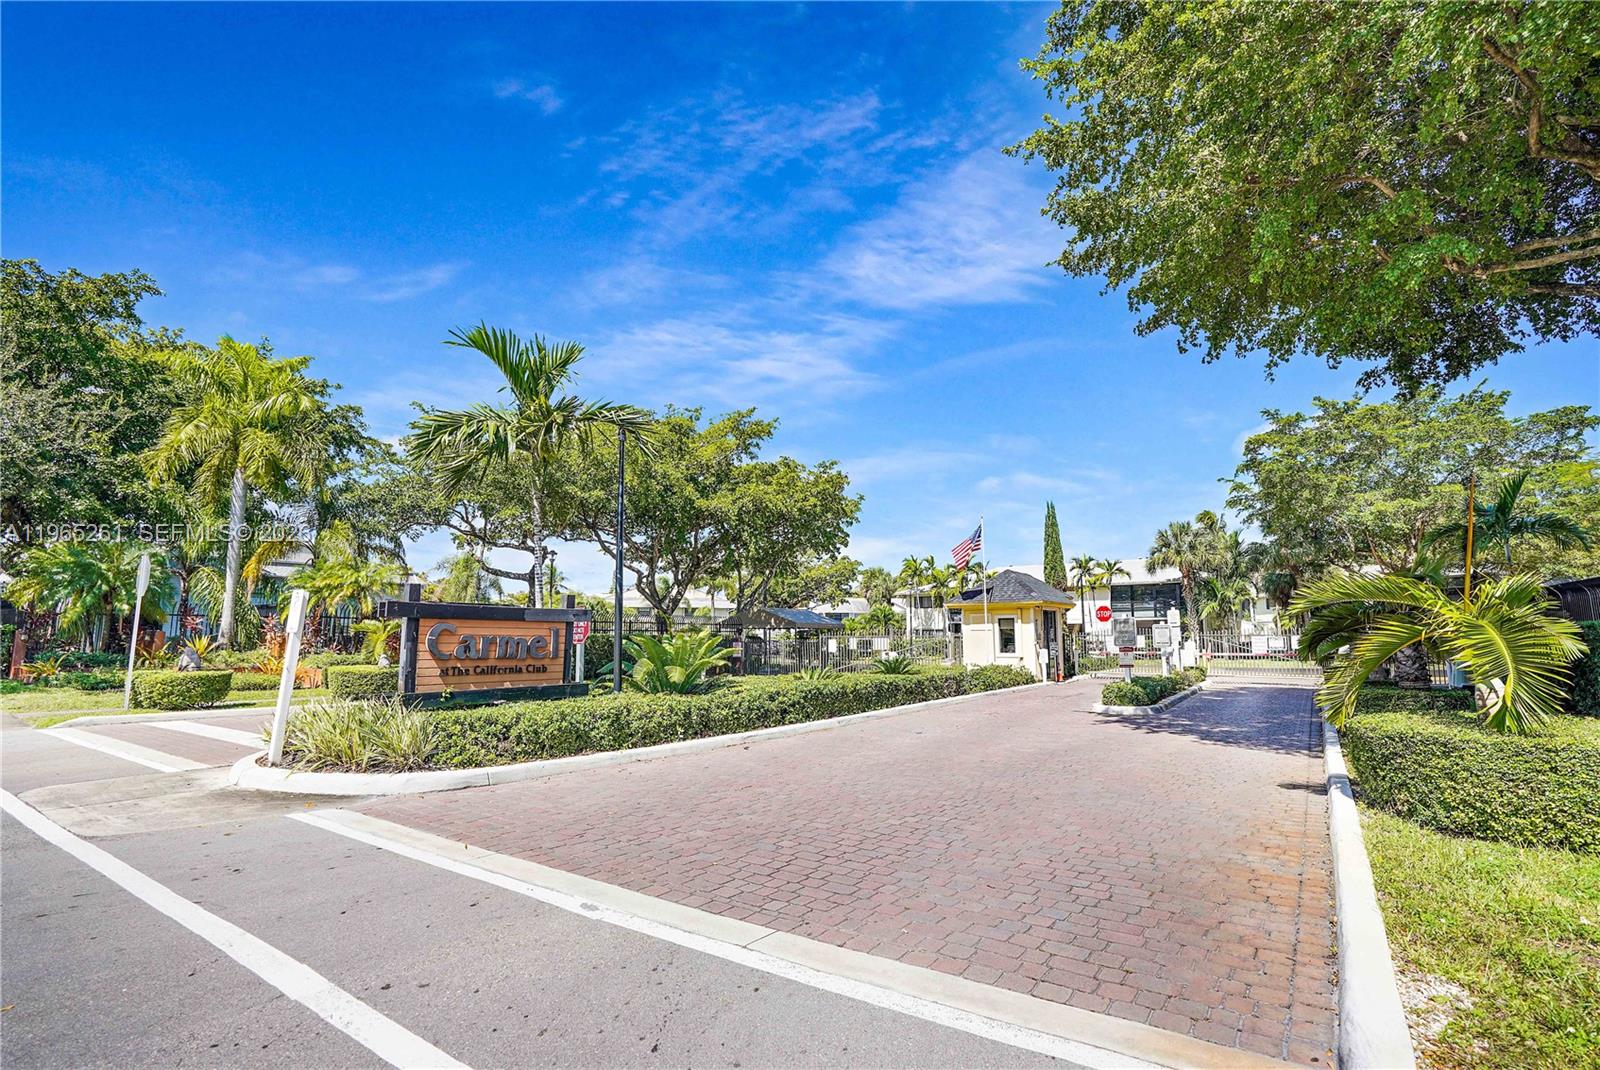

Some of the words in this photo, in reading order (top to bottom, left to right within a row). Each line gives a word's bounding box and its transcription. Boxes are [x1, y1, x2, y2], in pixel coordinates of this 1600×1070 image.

[1097, 610, 1112, 618] STOP
[425, 622, 560, 660] Carmel
[440, 667, 449, 677] at
[451, 665, 470, 676] The
[474, 664, 523, 676] California
[526, 664, 548, 674] Club
